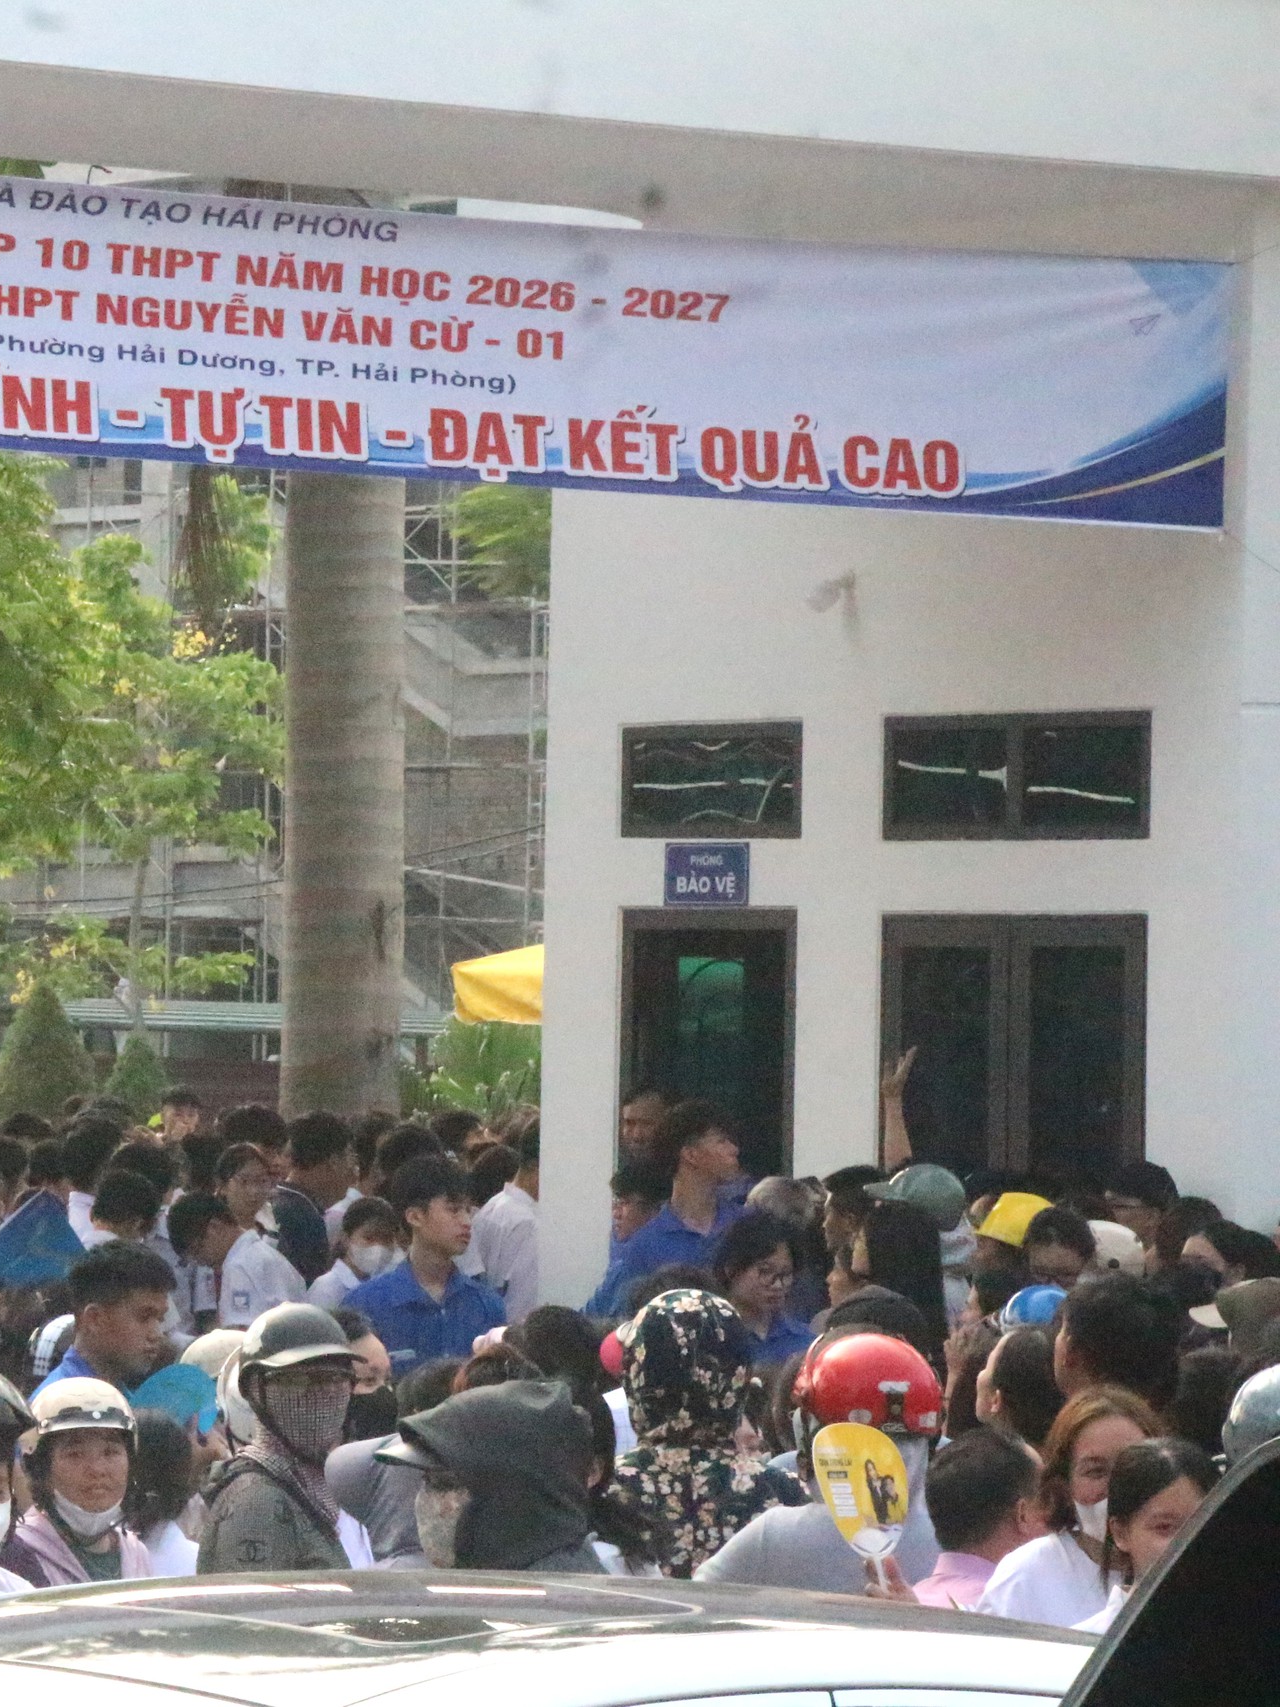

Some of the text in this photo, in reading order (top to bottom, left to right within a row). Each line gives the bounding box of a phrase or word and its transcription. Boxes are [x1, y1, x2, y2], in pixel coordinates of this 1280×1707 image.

[29, 187, 109, 216] ĐÀO
[120, 197, 192, 225] TẠO
[273, 211, 399, 242] PHÒNG
[37, 237, 89, 271] 10
[107, 243, 221, 282] THPT
[236, 251, 344, 292] NĂM
[361, 266, 451, 306] HỌC
[466, 275, 575, 311] 2026
[622, 287, 730, 323] 2027
[96, 292, 285, 338] NGUYỄN
[301, 307, 393, 347] VĂN
[410, 316, 474, 353] CỪ
[517, 328, 564, 360] 01
[117, 344, 166, 364] Hải
[178, 348, 285, 377] Dương,
[296, 358, 340, 378] TP.
[352, 363, 399, 383] Hải
[410, 367, 517, 395] Phòng)
[117, 409, 138, 421] -
[160, 387, 246, 458] TỰ
[259, 394, 362, 455] TIN
[386, 430, 407, 441] -
[428, 408, 546, 477] ĐẠT
[567, 404, 679, 476] KẾT
[700, 413, 824, 487] QUẢ
[844, 435, 959, 493] CAO
[676, 871, 736, 898] BẢO VỆ
